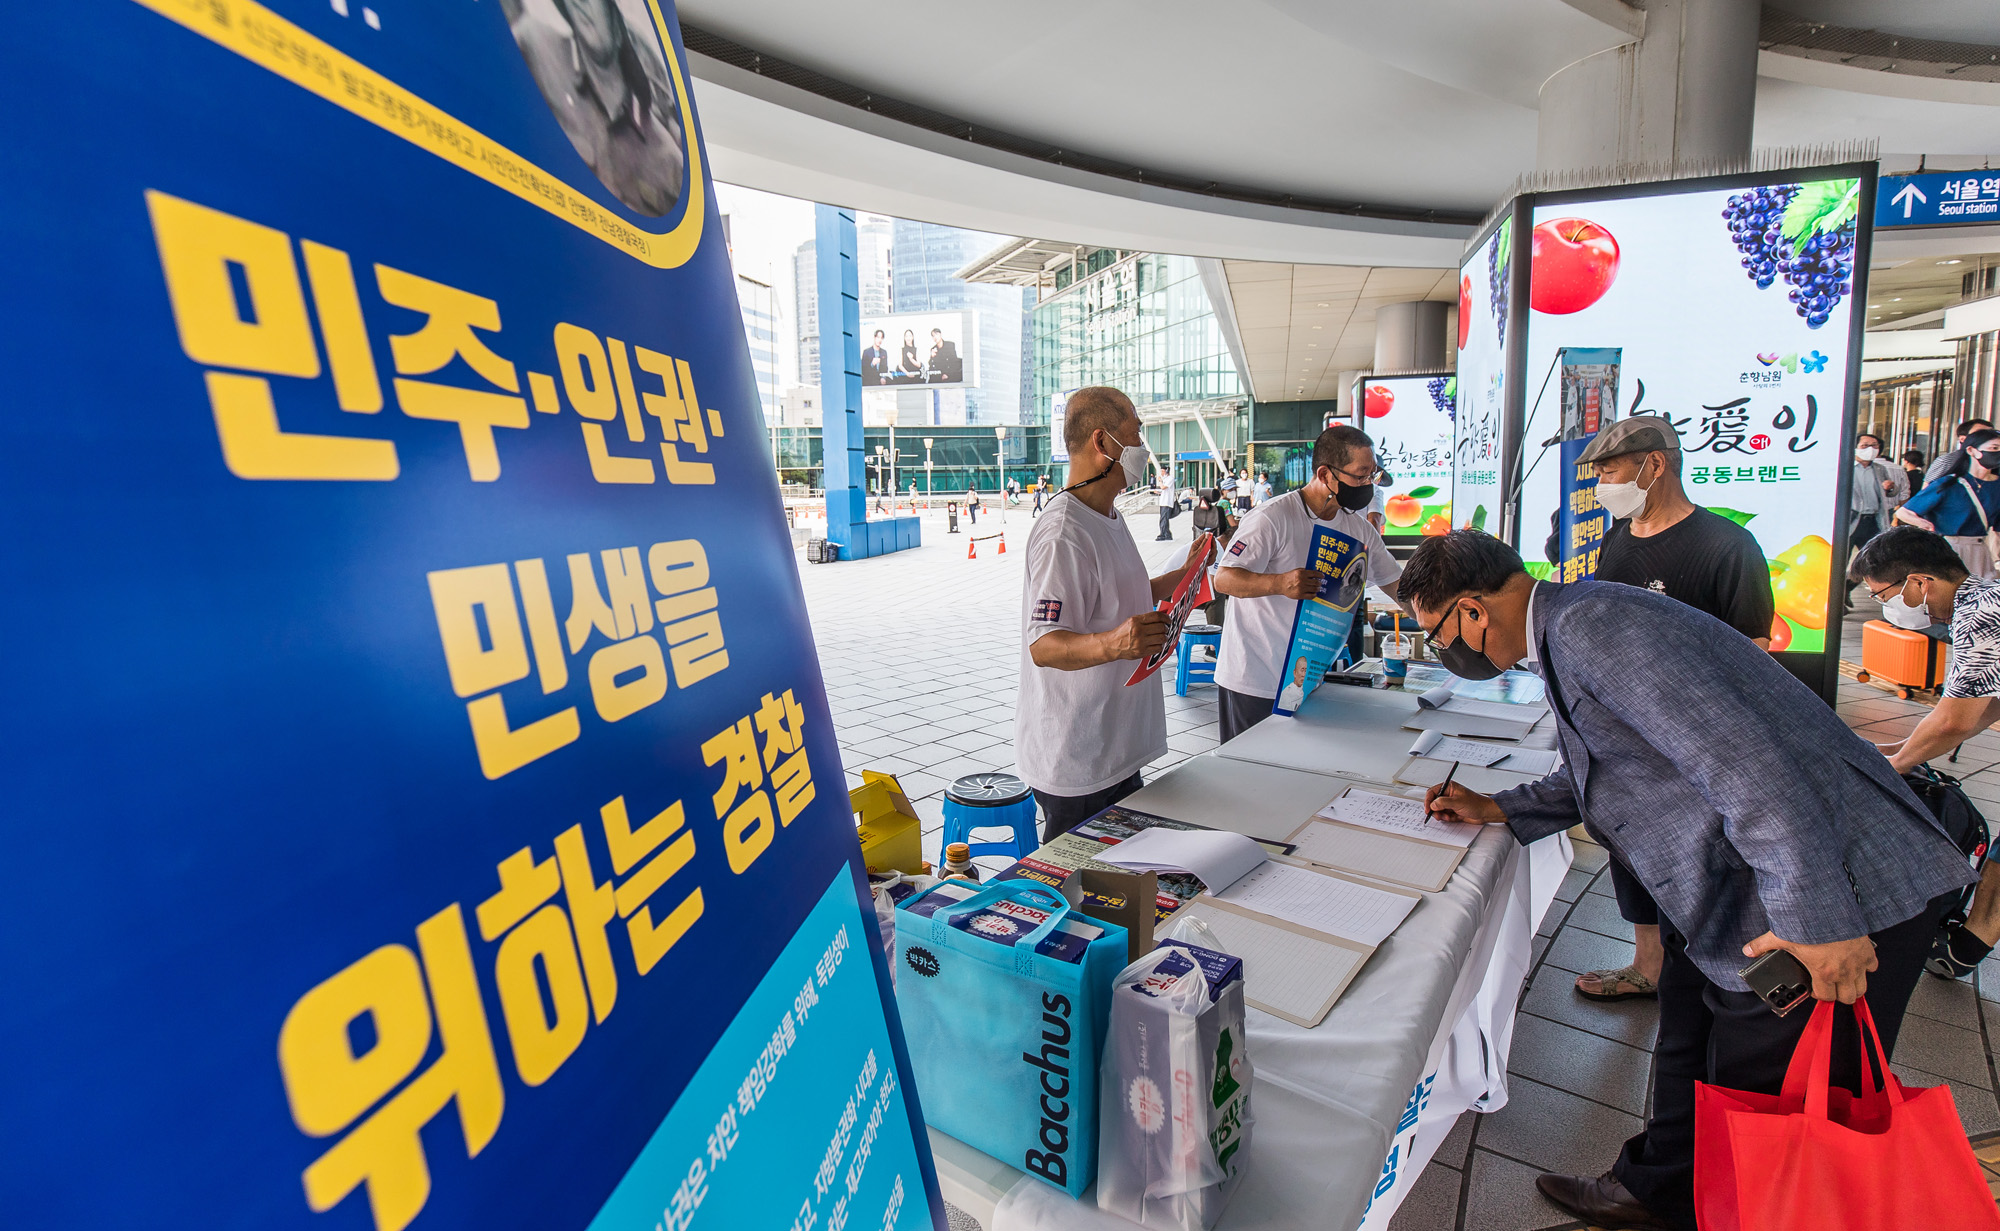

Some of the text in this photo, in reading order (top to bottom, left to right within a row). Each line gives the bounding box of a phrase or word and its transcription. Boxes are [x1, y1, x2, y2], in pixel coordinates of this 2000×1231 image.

[1940, 178, 2000, 200] 서울역
[1938, 202, 1998, 216] Seoul station
[1085, 260, 1137, 312] 서울역
[1740, 371, 1781, 383] 춘향남원
[1576, 461, 1598, 481] 시대
[1690, 465, 1801, 484] 공동브랜드
[1572, 516, 1604, 549] 행안부의
[1318, 547, 1339, 564] 민생을
[1563, 553, 1586, 584] 경찰국
[426, 538, 729, 781] 민생을
[976, 917, 1011, 934] 박카스
[277, 687, 816, 1231] 위하는 경찰
[909, 952, 938, 972] 박카스
[707, 1103, 739, 1172] 치안
[737, 1010, 797, 1116] 책임강화를
[814, 924, 850, 988] 독립성이
[855, 1048, 878, 1108] 시대를
[1023, 990, 1072, 1188] Bacchus
